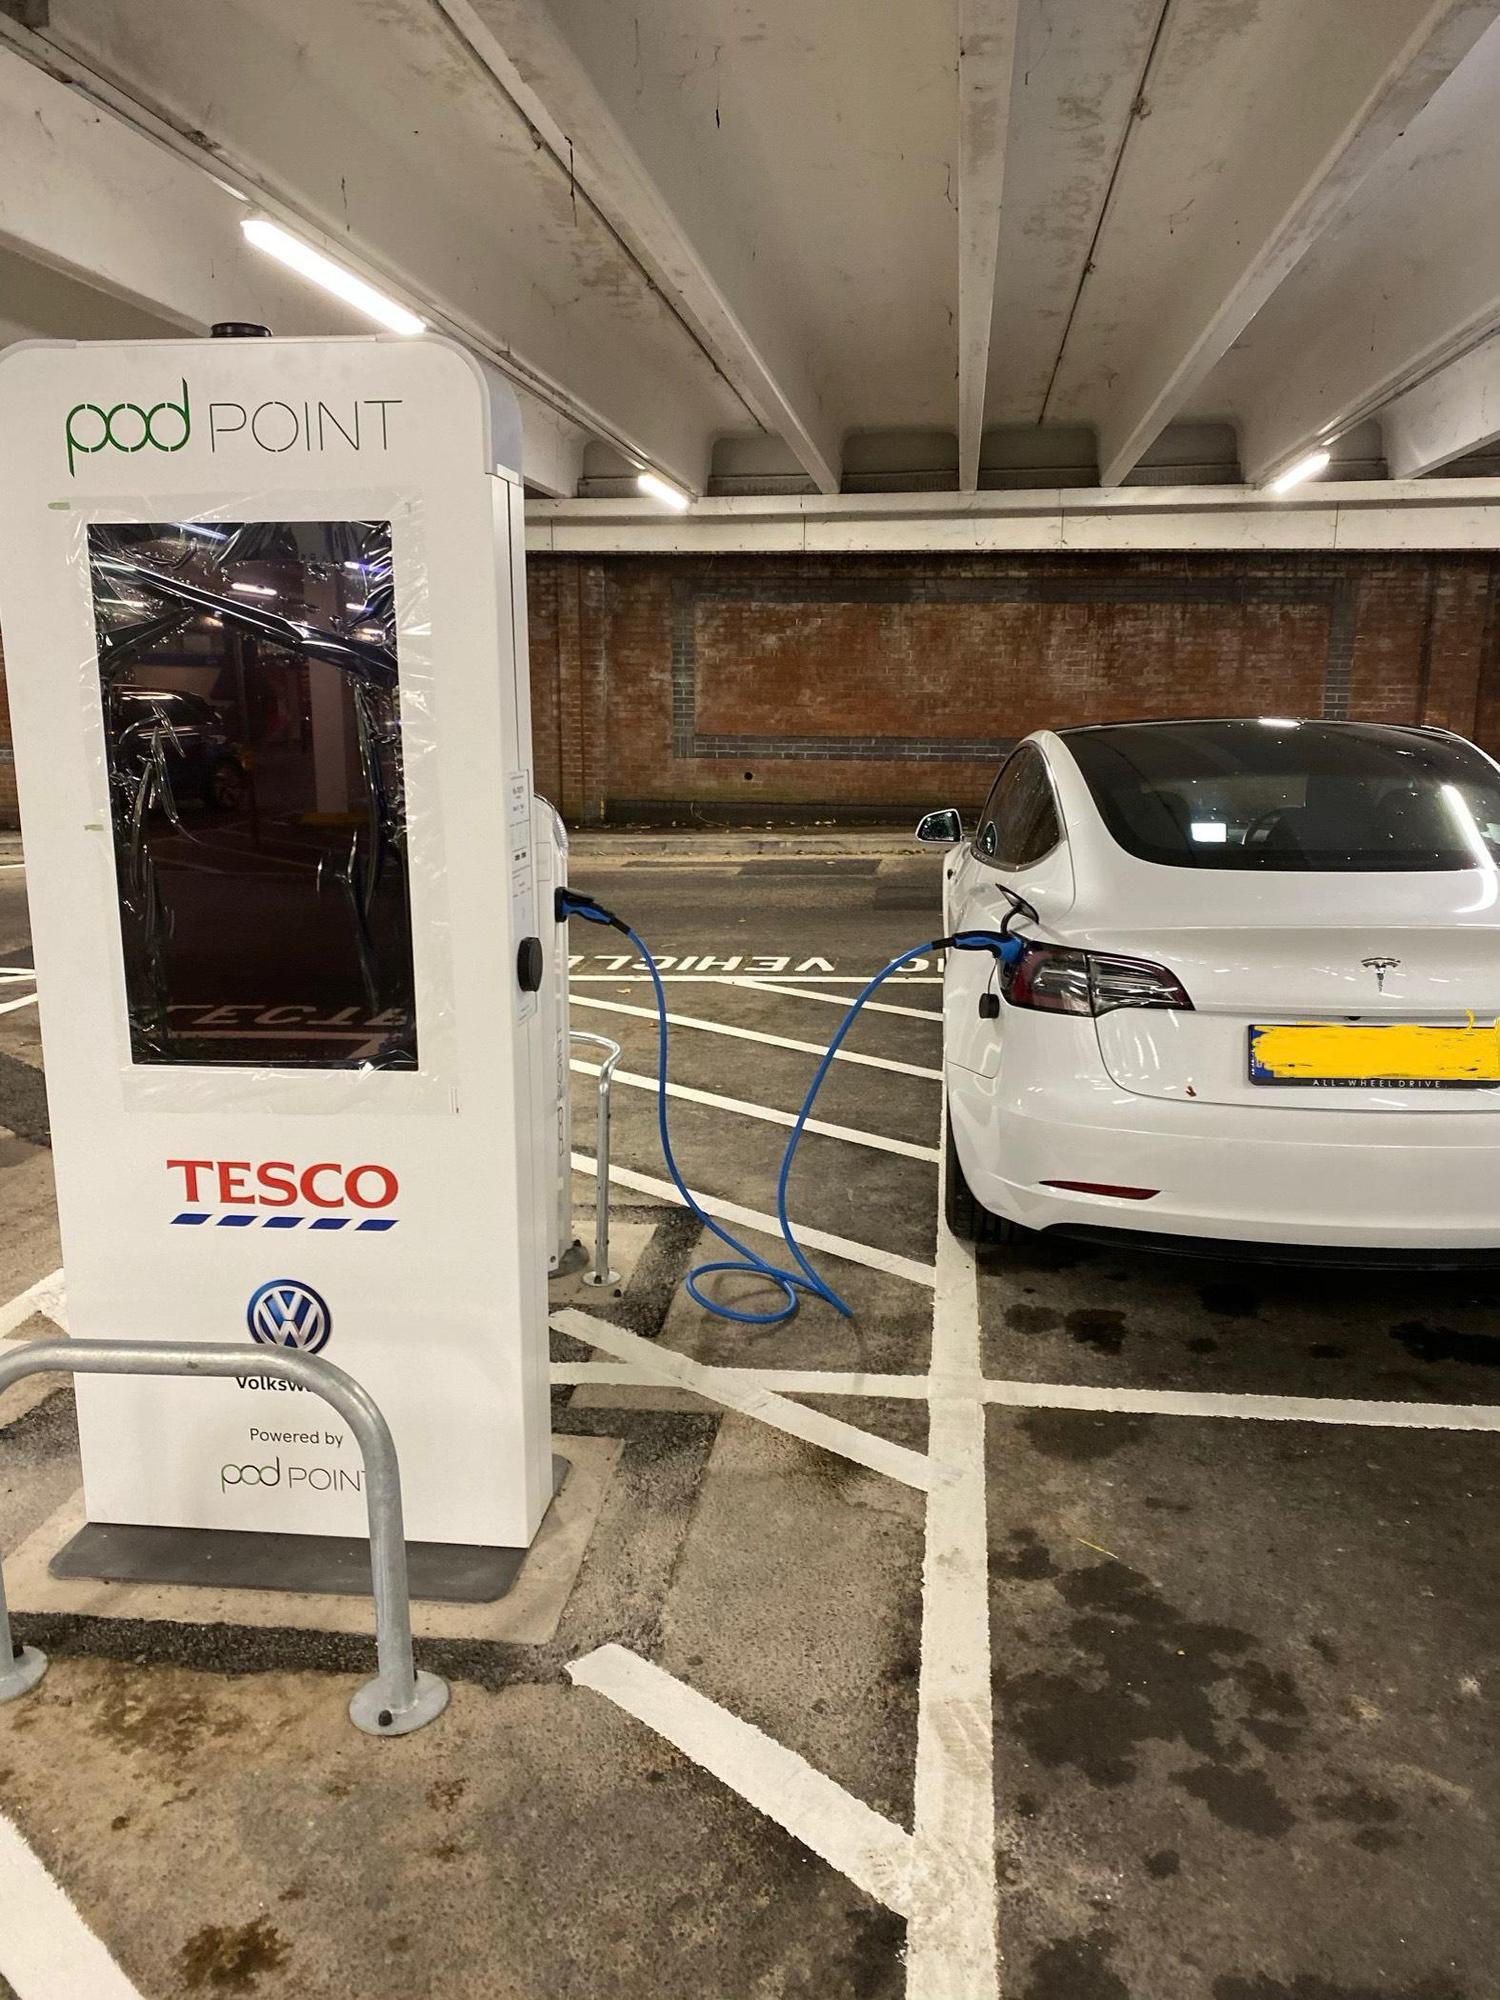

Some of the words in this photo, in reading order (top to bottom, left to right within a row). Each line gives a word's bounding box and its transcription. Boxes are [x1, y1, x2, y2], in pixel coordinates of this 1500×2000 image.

[66, 378, 191, 477] pod
[210, 400, 403, 453] POINT
[166, 1159, 399, 1208] TESCO
[235, 1376, 312, 1393] Volksw
[250, 1428, 320, 1445] Powered
[325, 1432, 344, 1449] by
[221, 1456, 281, 1494] pod
[288, 1466, 367, 1492] POIN
